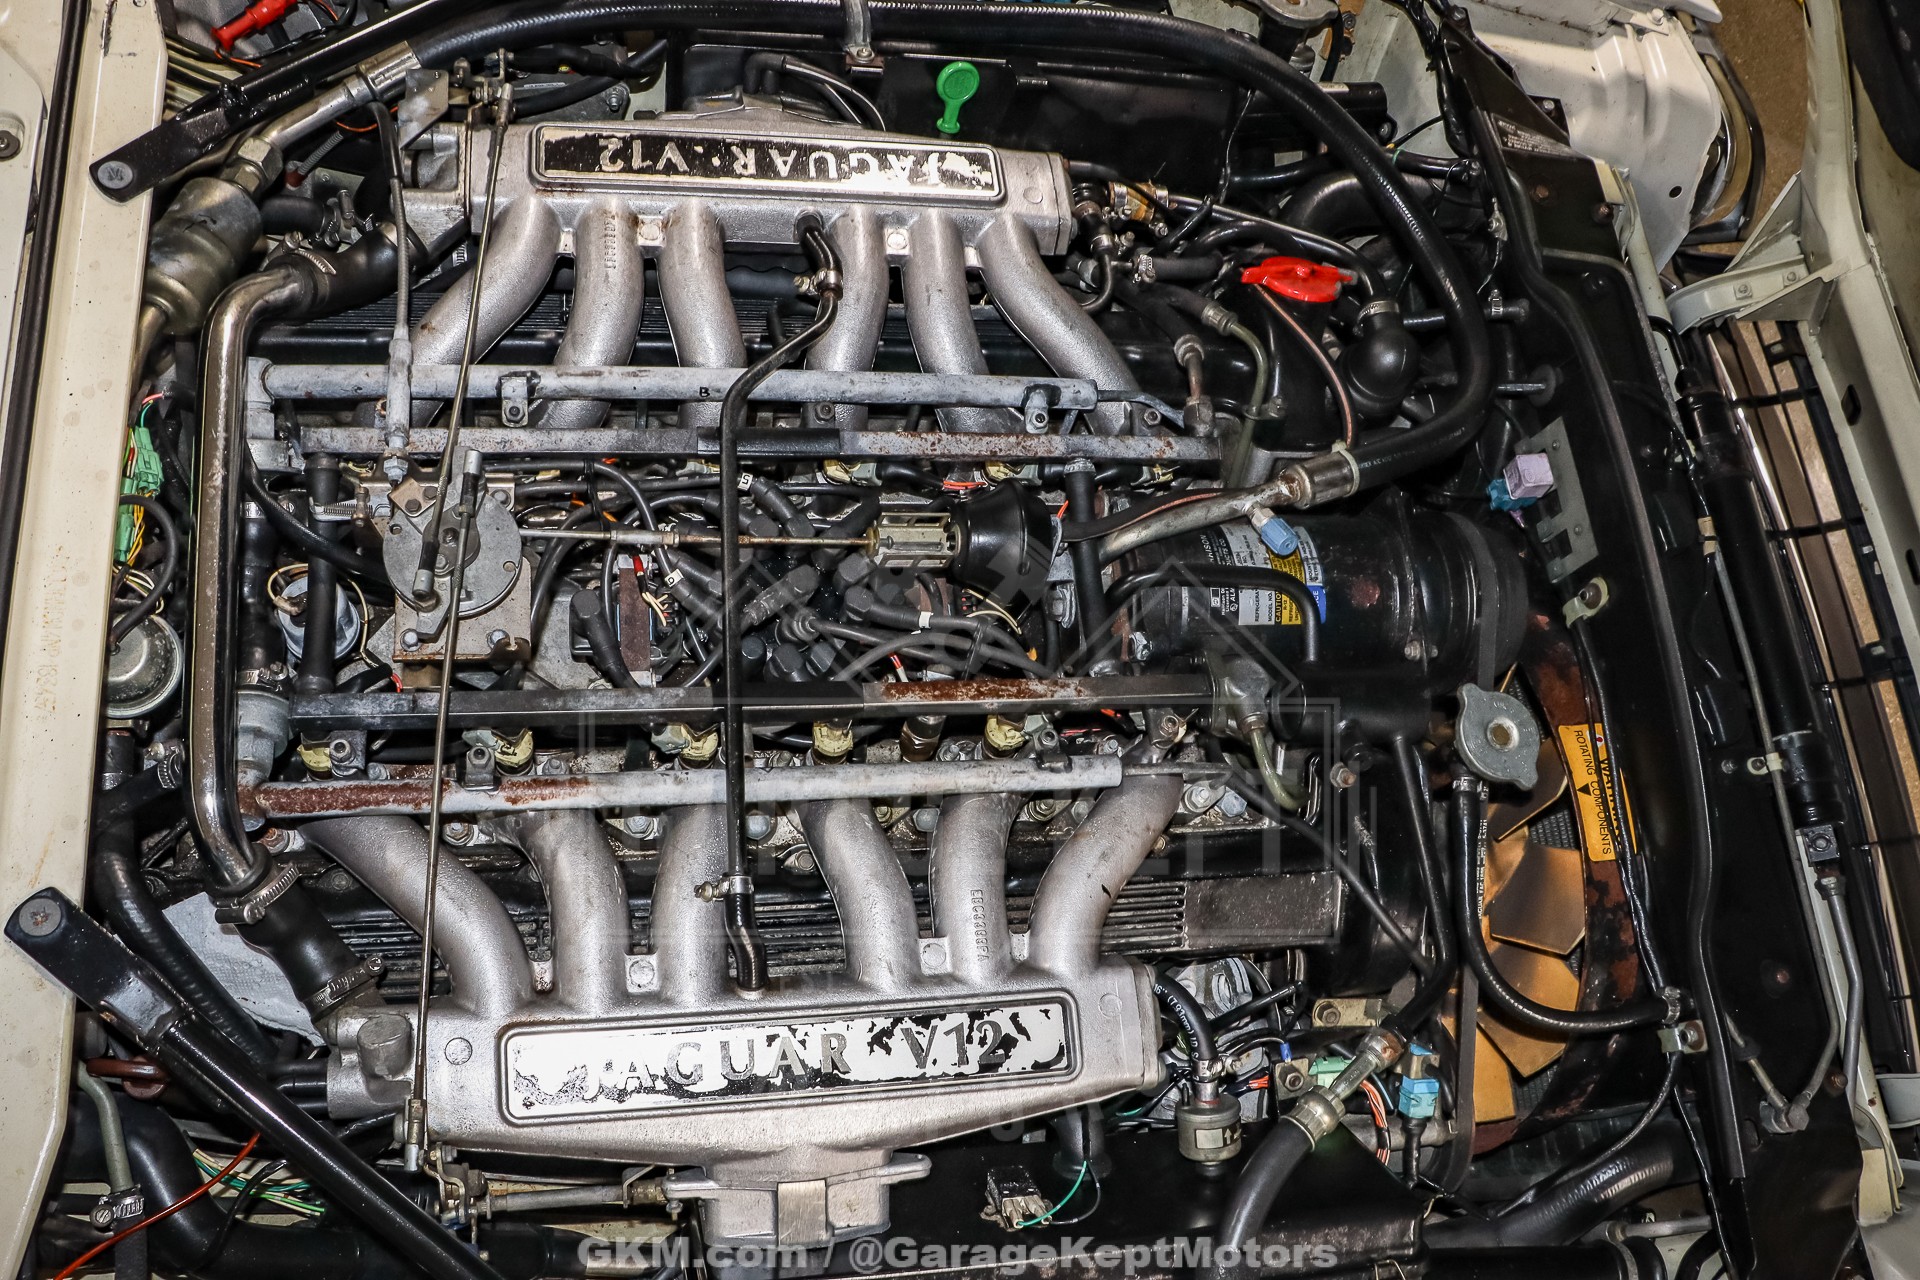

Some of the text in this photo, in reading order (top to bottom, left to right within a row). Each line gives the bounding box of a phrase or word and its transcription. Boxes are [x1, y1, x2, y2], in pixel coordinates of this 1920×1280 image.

[596, 136, 690, 174] V12
[1574, 729, 1612, 856] ROTATING COMPONENTS
[899, 1019, 1007, 1071] V12
